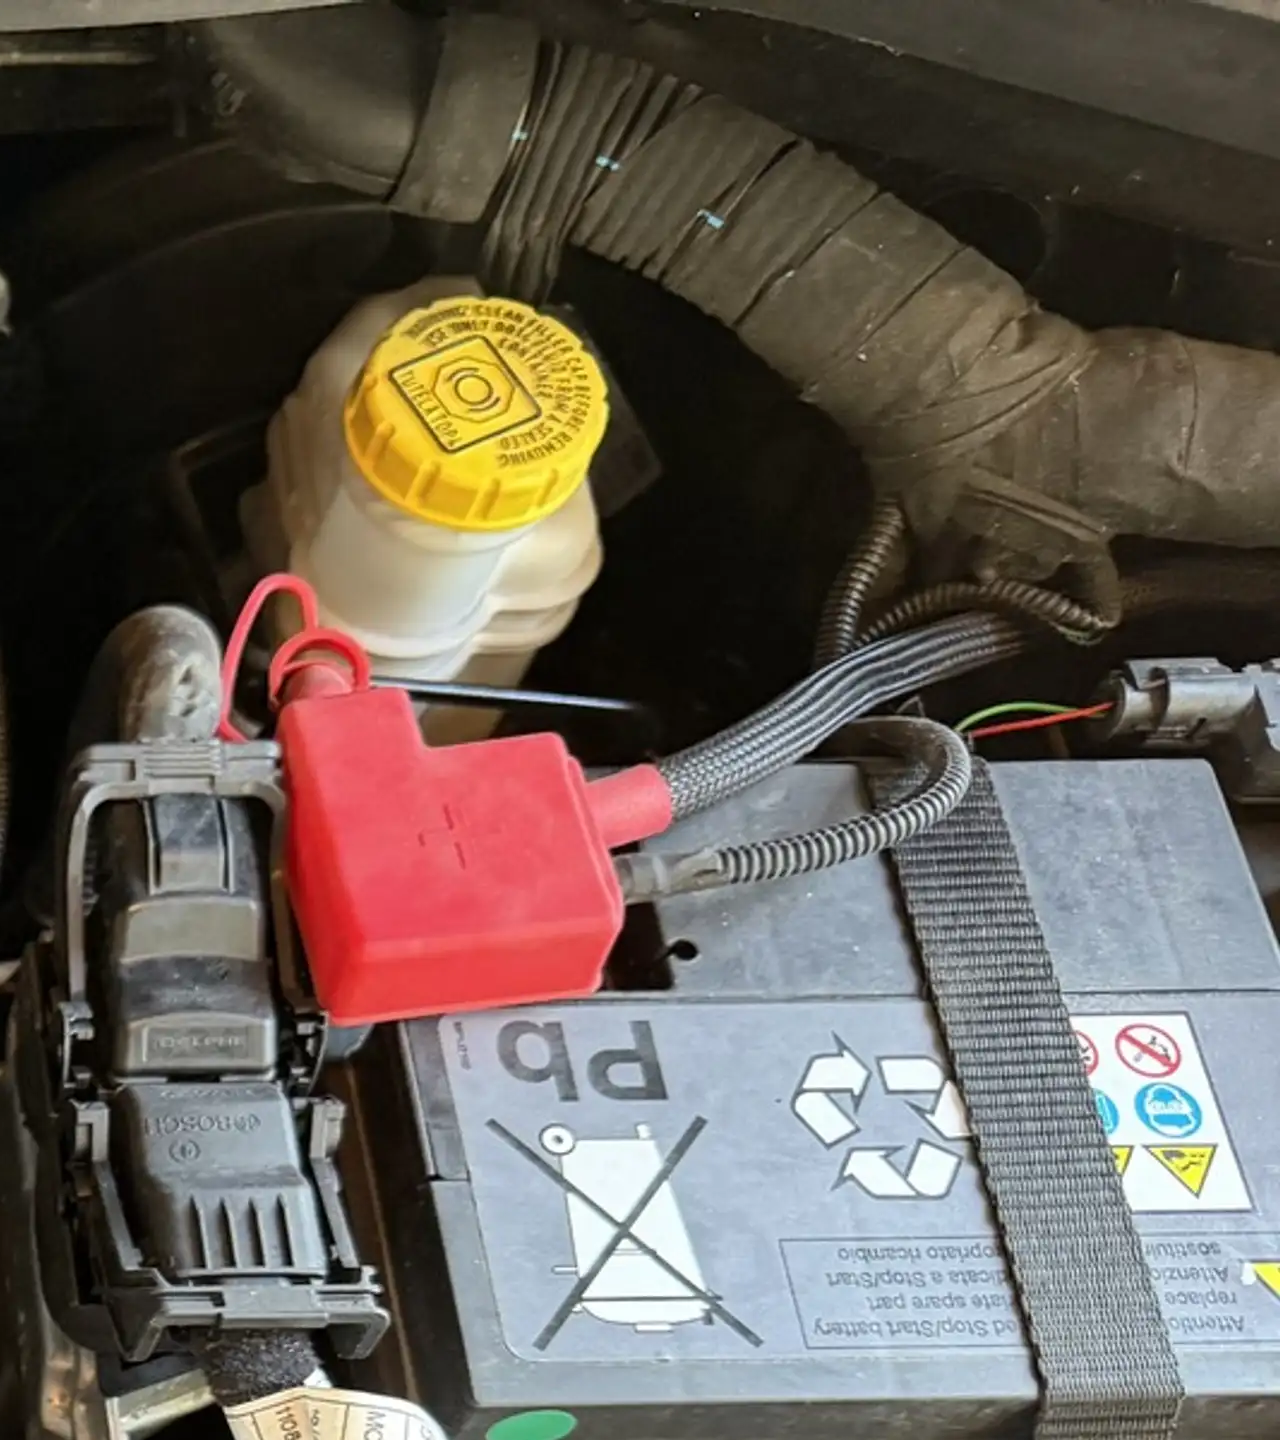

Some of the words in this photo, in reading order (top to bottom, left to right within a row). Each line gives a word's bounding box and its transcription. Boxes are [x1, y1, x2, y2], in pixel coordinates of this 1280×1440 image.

[566, 356, 588, 380] CAP
[571, 385, 592, 430] BEFORE
[499, 426, 554, 450] SEALED
[497, 432, 573, 468] REMOVING
[496, 1020, 668, 1101] Pb
[838, 1246, 921, 1263] ricambio
[825, 1270, 926, 1288] Stop/Start
[865, 1294, 907, 1311] part
[911, 1292, 966, 1310] spare
[1164, 1289, 1238, 1309] replace
[813, 1318, 881, 1336] battery
[888, 1319, 989, 1337] Stop/Start
[1169, 1315, 1245, 1334] Attentio
